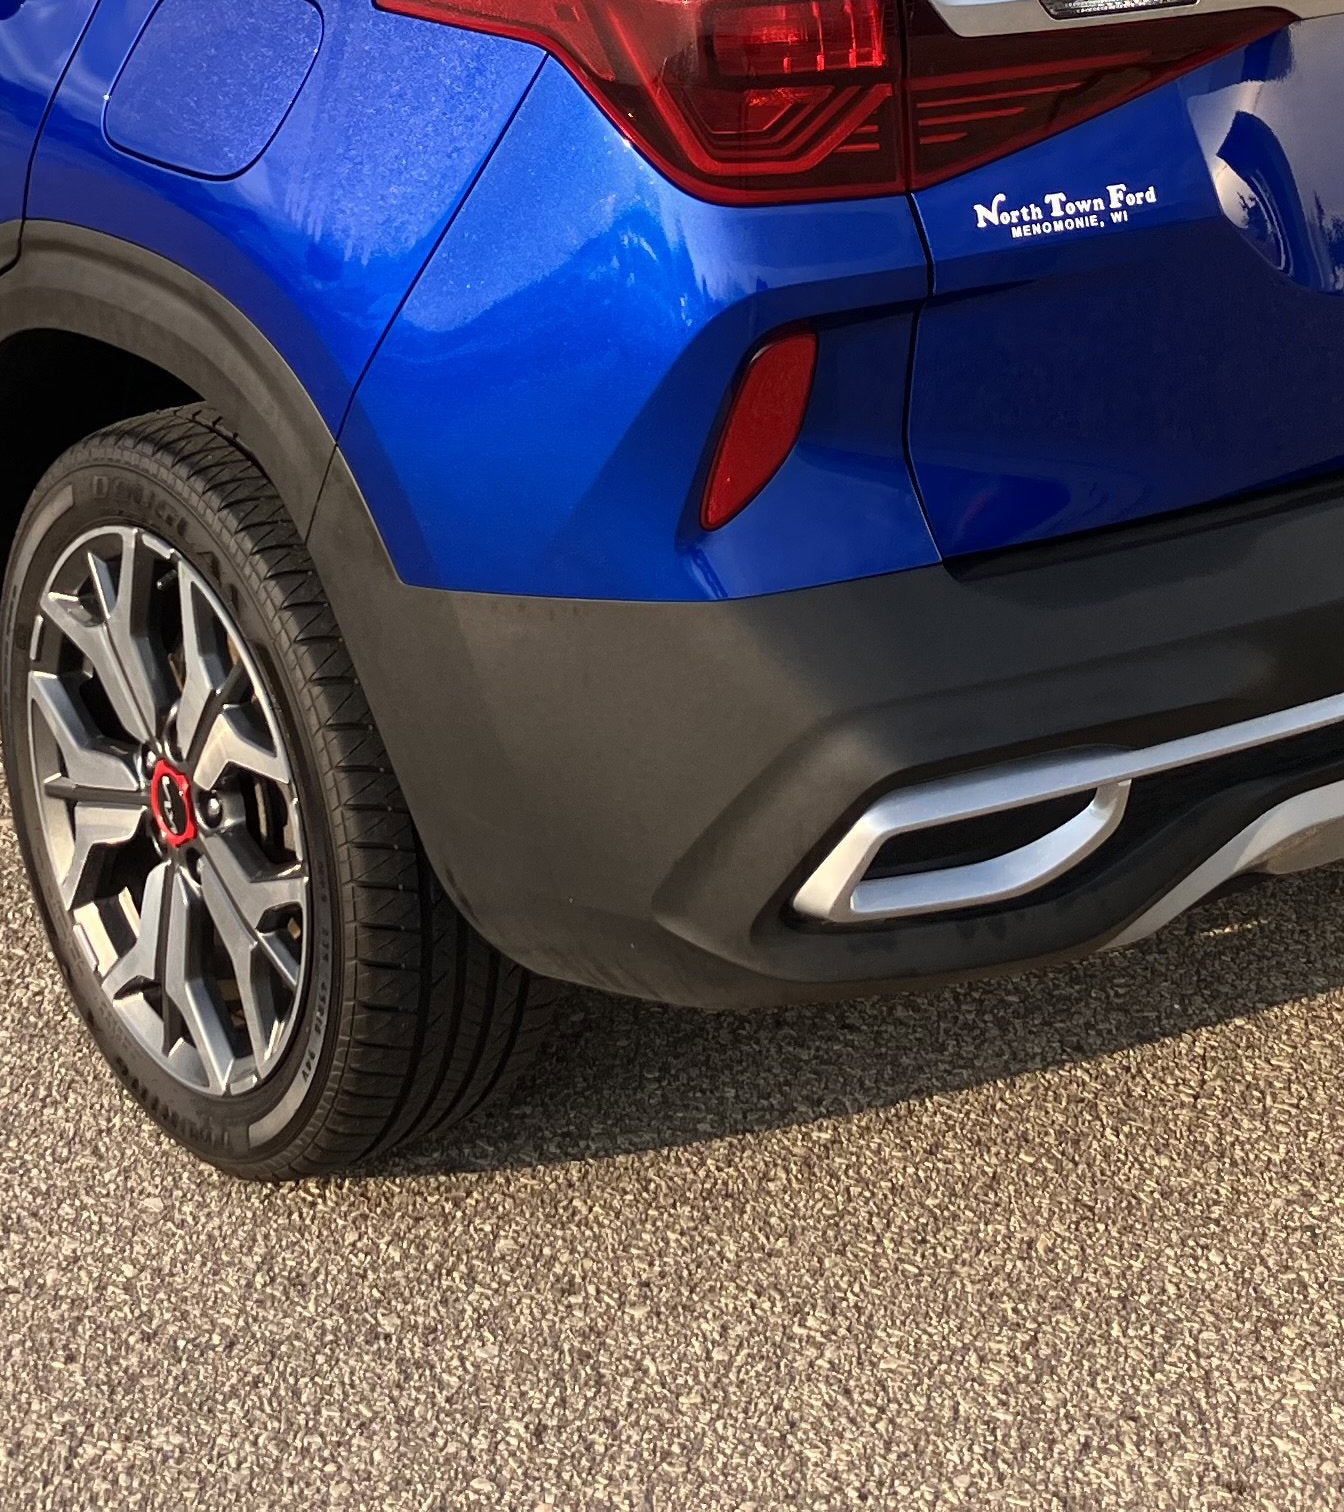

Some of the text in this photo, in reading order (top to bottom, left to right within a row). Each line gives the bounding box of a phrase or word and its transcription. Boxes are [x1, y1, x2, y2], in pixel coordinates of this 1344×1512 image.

[973, 184, 1157, 228] North Town Ford
[1011, 211, 1128, 238] MENOMONIE, WI
